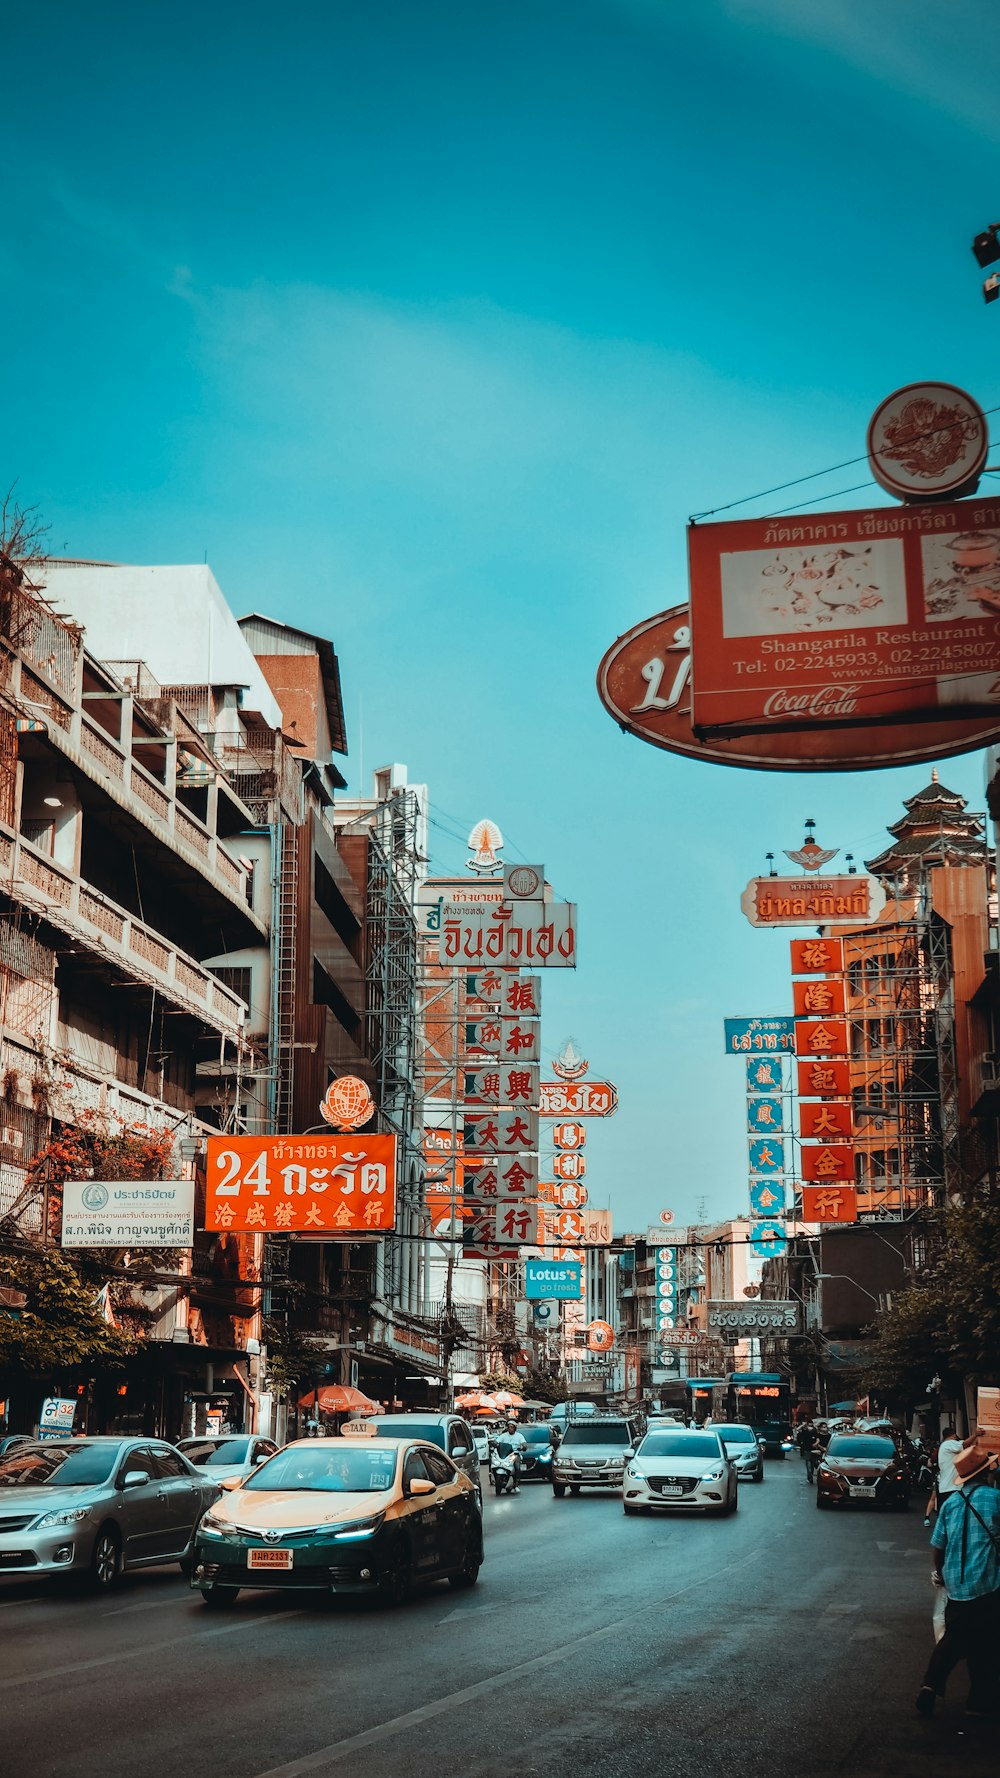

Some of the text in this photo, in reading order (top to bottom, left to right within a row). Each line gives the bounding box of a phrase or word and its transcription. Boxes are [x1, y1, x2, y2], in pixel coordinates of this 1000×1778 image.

[763, 522, 848, 544] ภัตตาคาร
[761, 625, 985, 654] Shangarila Restaurant
[733, 660, 767, 674] Tel:
[774, 651, 883, 672] 02-2245933,
[763, 685, 862, 719] Coca-Cola
[272, 1141, 337, 1159] ห้างทอง
[215, 1150, 271, 1196] 24
[529, 1268, 576, 1280] Lotus's
[540, 1283, 576, 1292] go fresh
[61, 1404, 74, 1414] 32
[350, 1424, 367, 1433] TAXI
